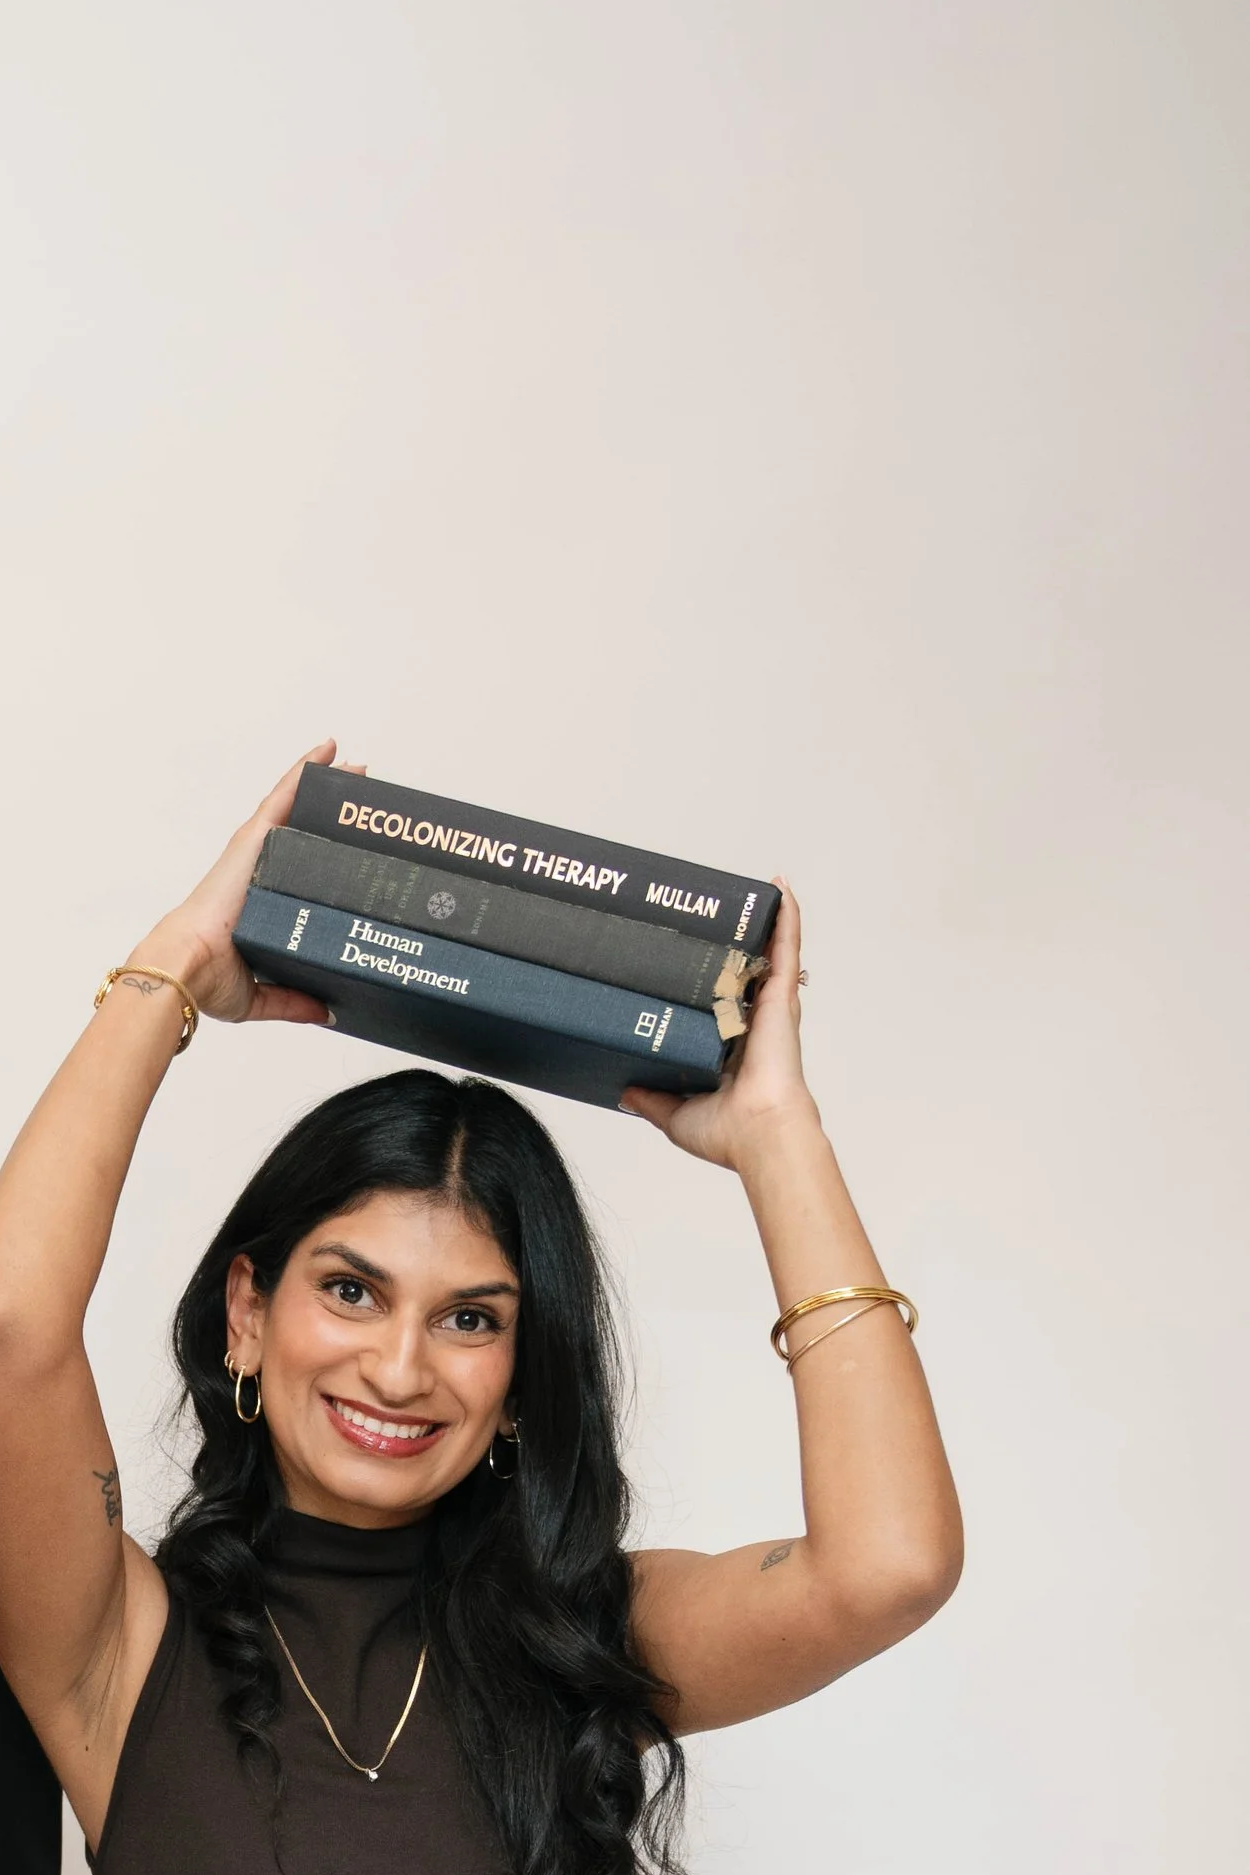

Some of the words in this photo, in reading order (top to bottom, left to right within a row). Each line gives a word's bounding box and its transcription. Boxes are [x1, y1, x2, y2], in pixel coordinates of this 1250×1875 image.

[337, 800, 517, 868] DECOLONIZING
[523, 847, 629, 895] THERAPY
[645, 882, 721, 919] MULLAN
[286, 908, 311, 952] BOWER
[347, 919, 424, 957] Human
[733, 892, 758, 942] NORTON
[339, 943, 471, 995] Development
[651, 1006, 674, 1053] FREEMAN
